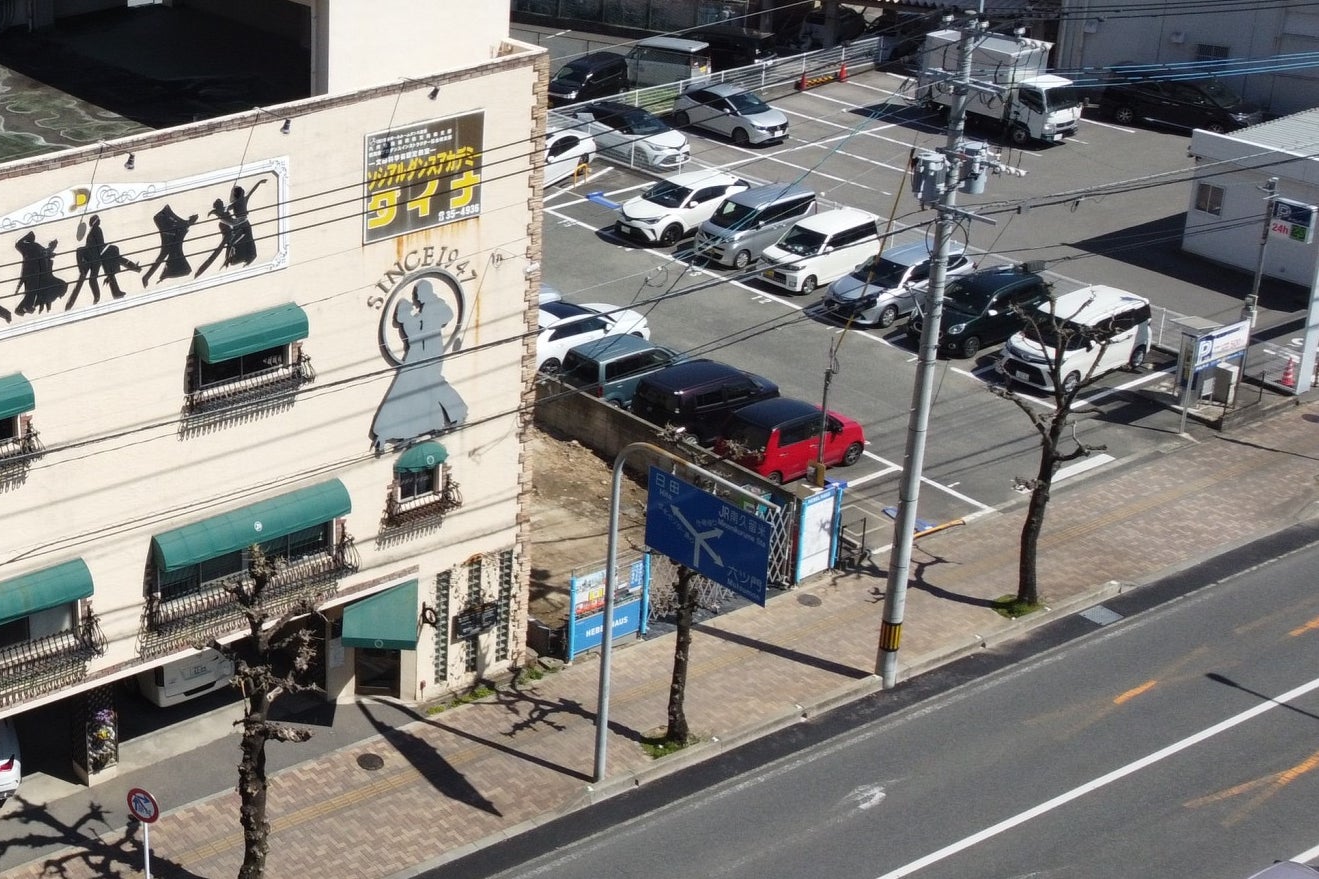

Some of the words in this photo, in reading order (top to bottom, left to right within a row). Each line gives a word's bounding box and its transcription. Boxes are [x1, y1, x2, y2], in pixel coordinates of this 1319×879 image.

[367, 246, 435, 310] SINCE
[656, 472, 680, 495] 日田
[727, 566, 762, 593] 六ツ門
[585, 624, 604, 638] HEB
